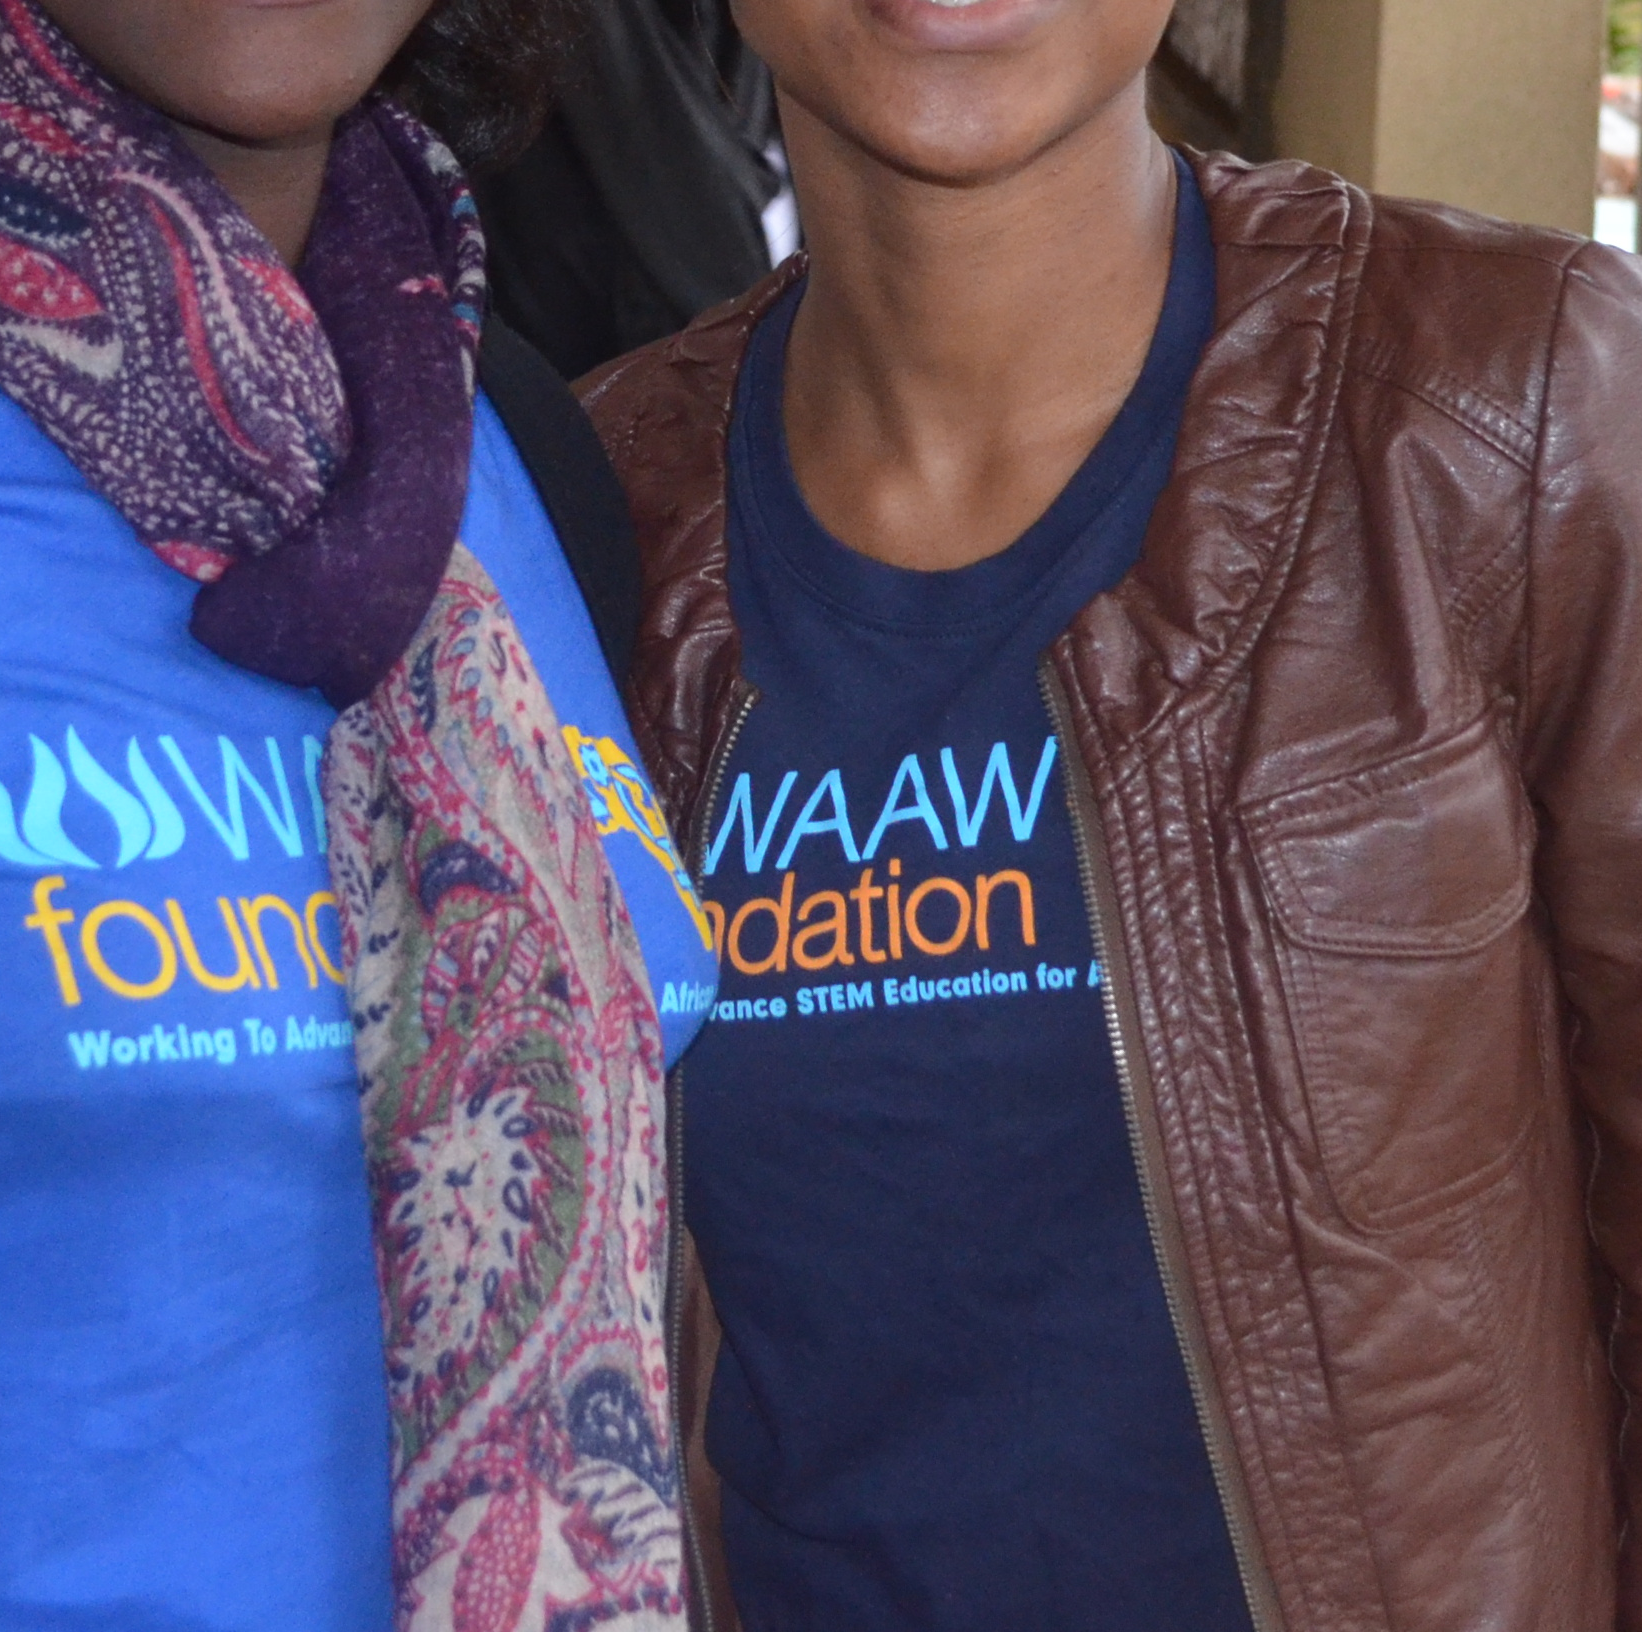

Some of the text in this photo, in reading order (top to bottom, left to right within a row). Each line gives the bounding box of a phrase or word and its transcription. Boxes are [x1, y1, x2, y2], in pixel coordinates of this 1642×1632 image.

[703, 735, 1058, 875] WAAW
[796, 980, 875, 1016] STEM
[883, 968, 1028, 1006] Education
[1036, 961, 1078, 990] for
[68, 1022, 237, 1069] Working
[243, 1017, 278, 1055] To
